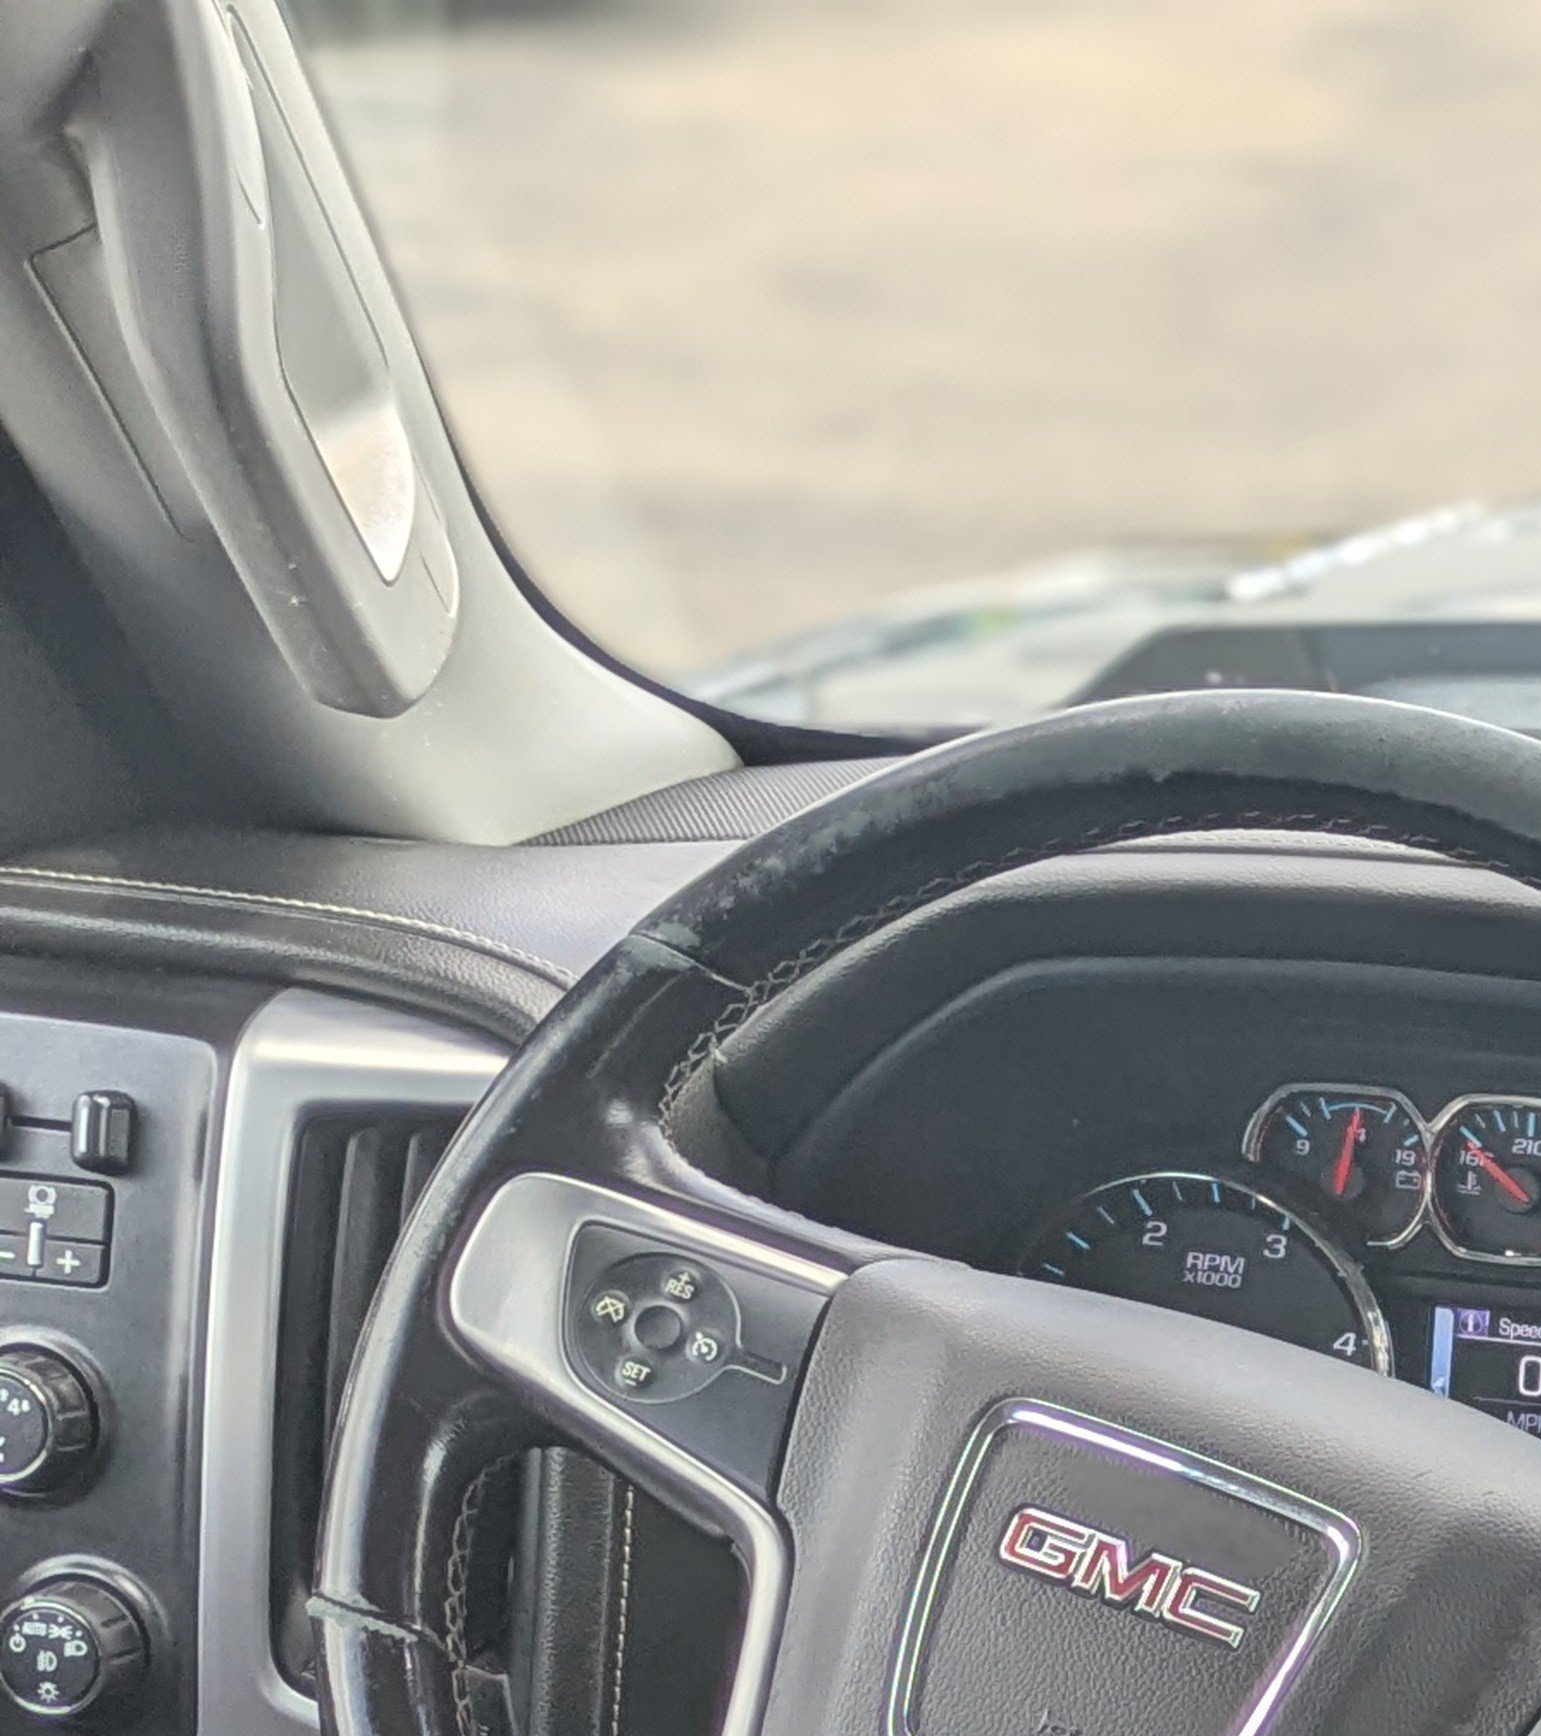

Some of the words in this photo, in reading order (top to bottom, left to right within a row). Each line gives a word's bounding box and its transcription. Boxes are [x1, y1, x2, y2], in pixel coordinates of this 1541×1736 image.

[1296, 1139, 1310, 1157] 9
[1395, 1148, 1417, 1167] 19
[1142, 1221, 1168, 1248] 2
[1263, 1234, 1288, 1261] 3
[1186, 1251, 1246, 1275] RPM
[664, 1280, 694, 1300] RES
[1333, 1331, 1358, 1357] 4
[622, 1361, 651, 1381] SET
[997, 1507, 1262, 1651] GMC
